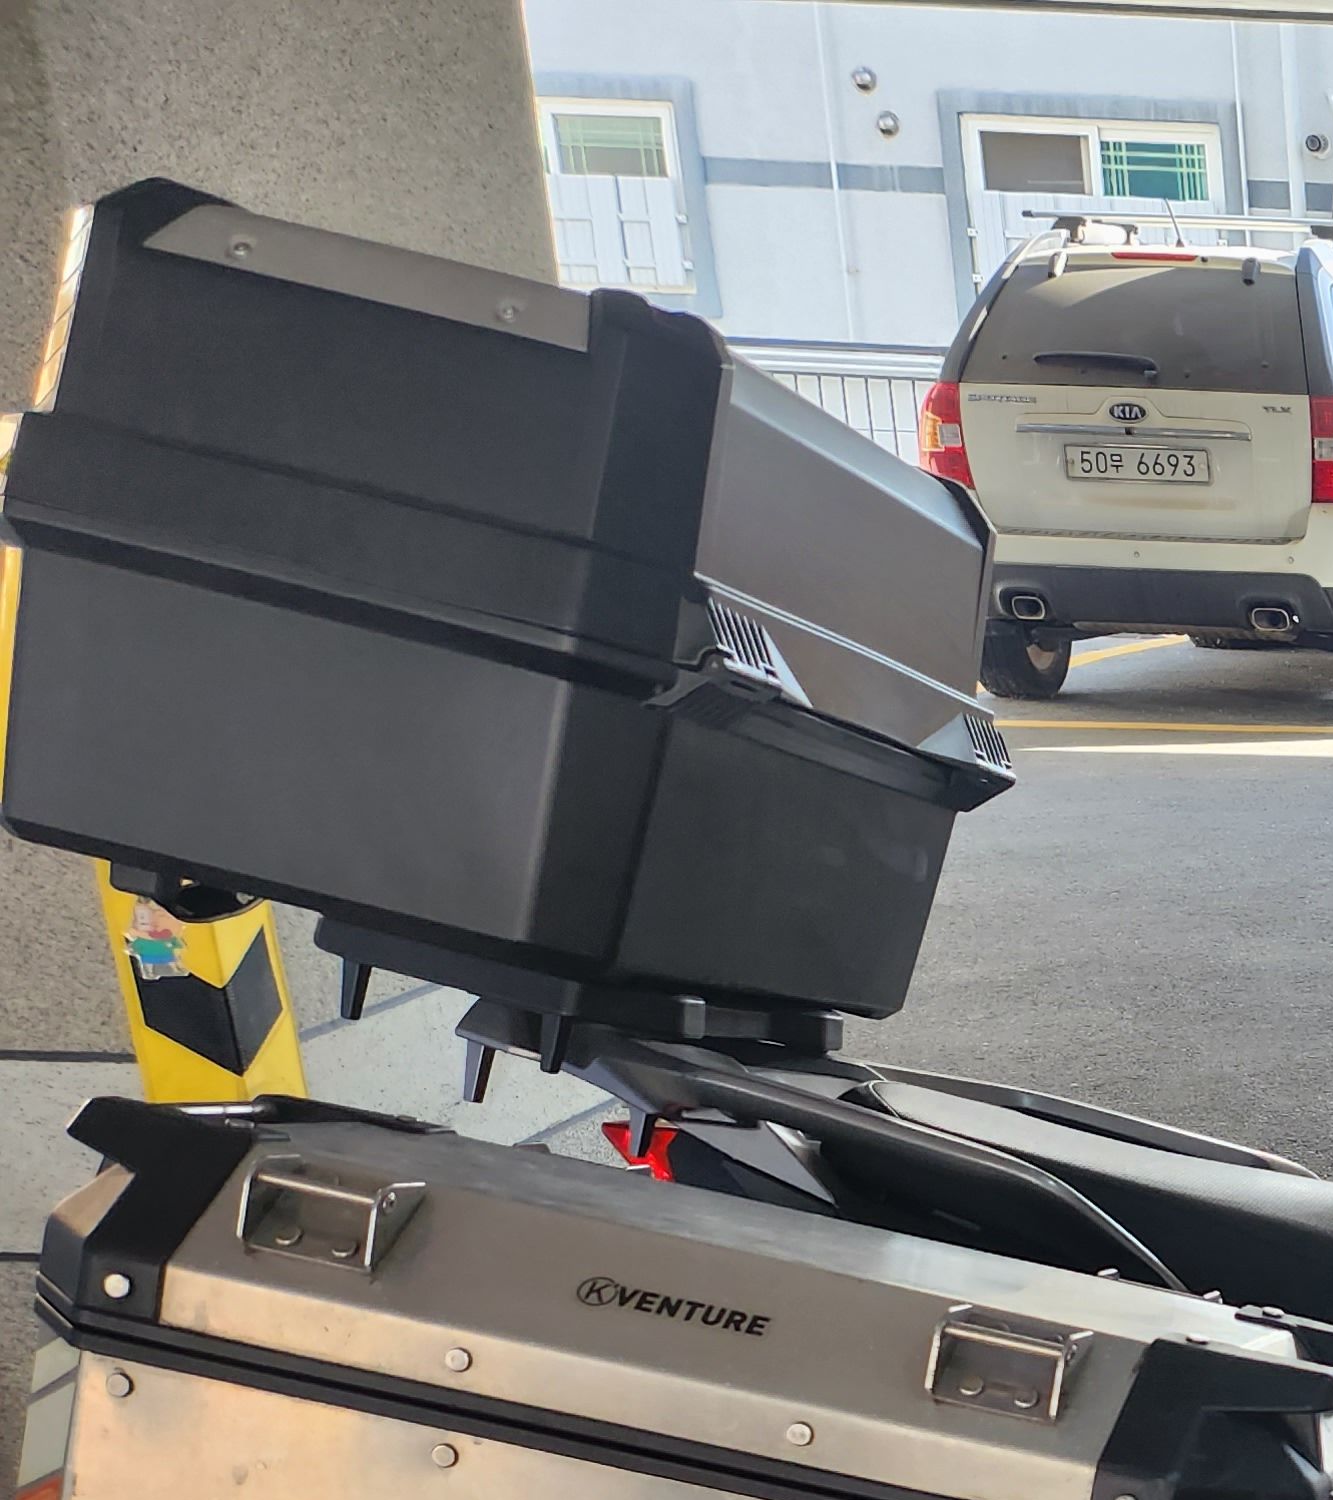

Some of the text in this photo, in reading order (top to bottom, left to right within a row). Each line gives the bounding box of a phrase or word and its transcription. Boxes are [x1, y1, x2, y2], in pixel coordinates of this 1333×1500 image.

[1113, 405, 1142, 420] KIA
[1080, 450, 1196, 478] 50무 6693
